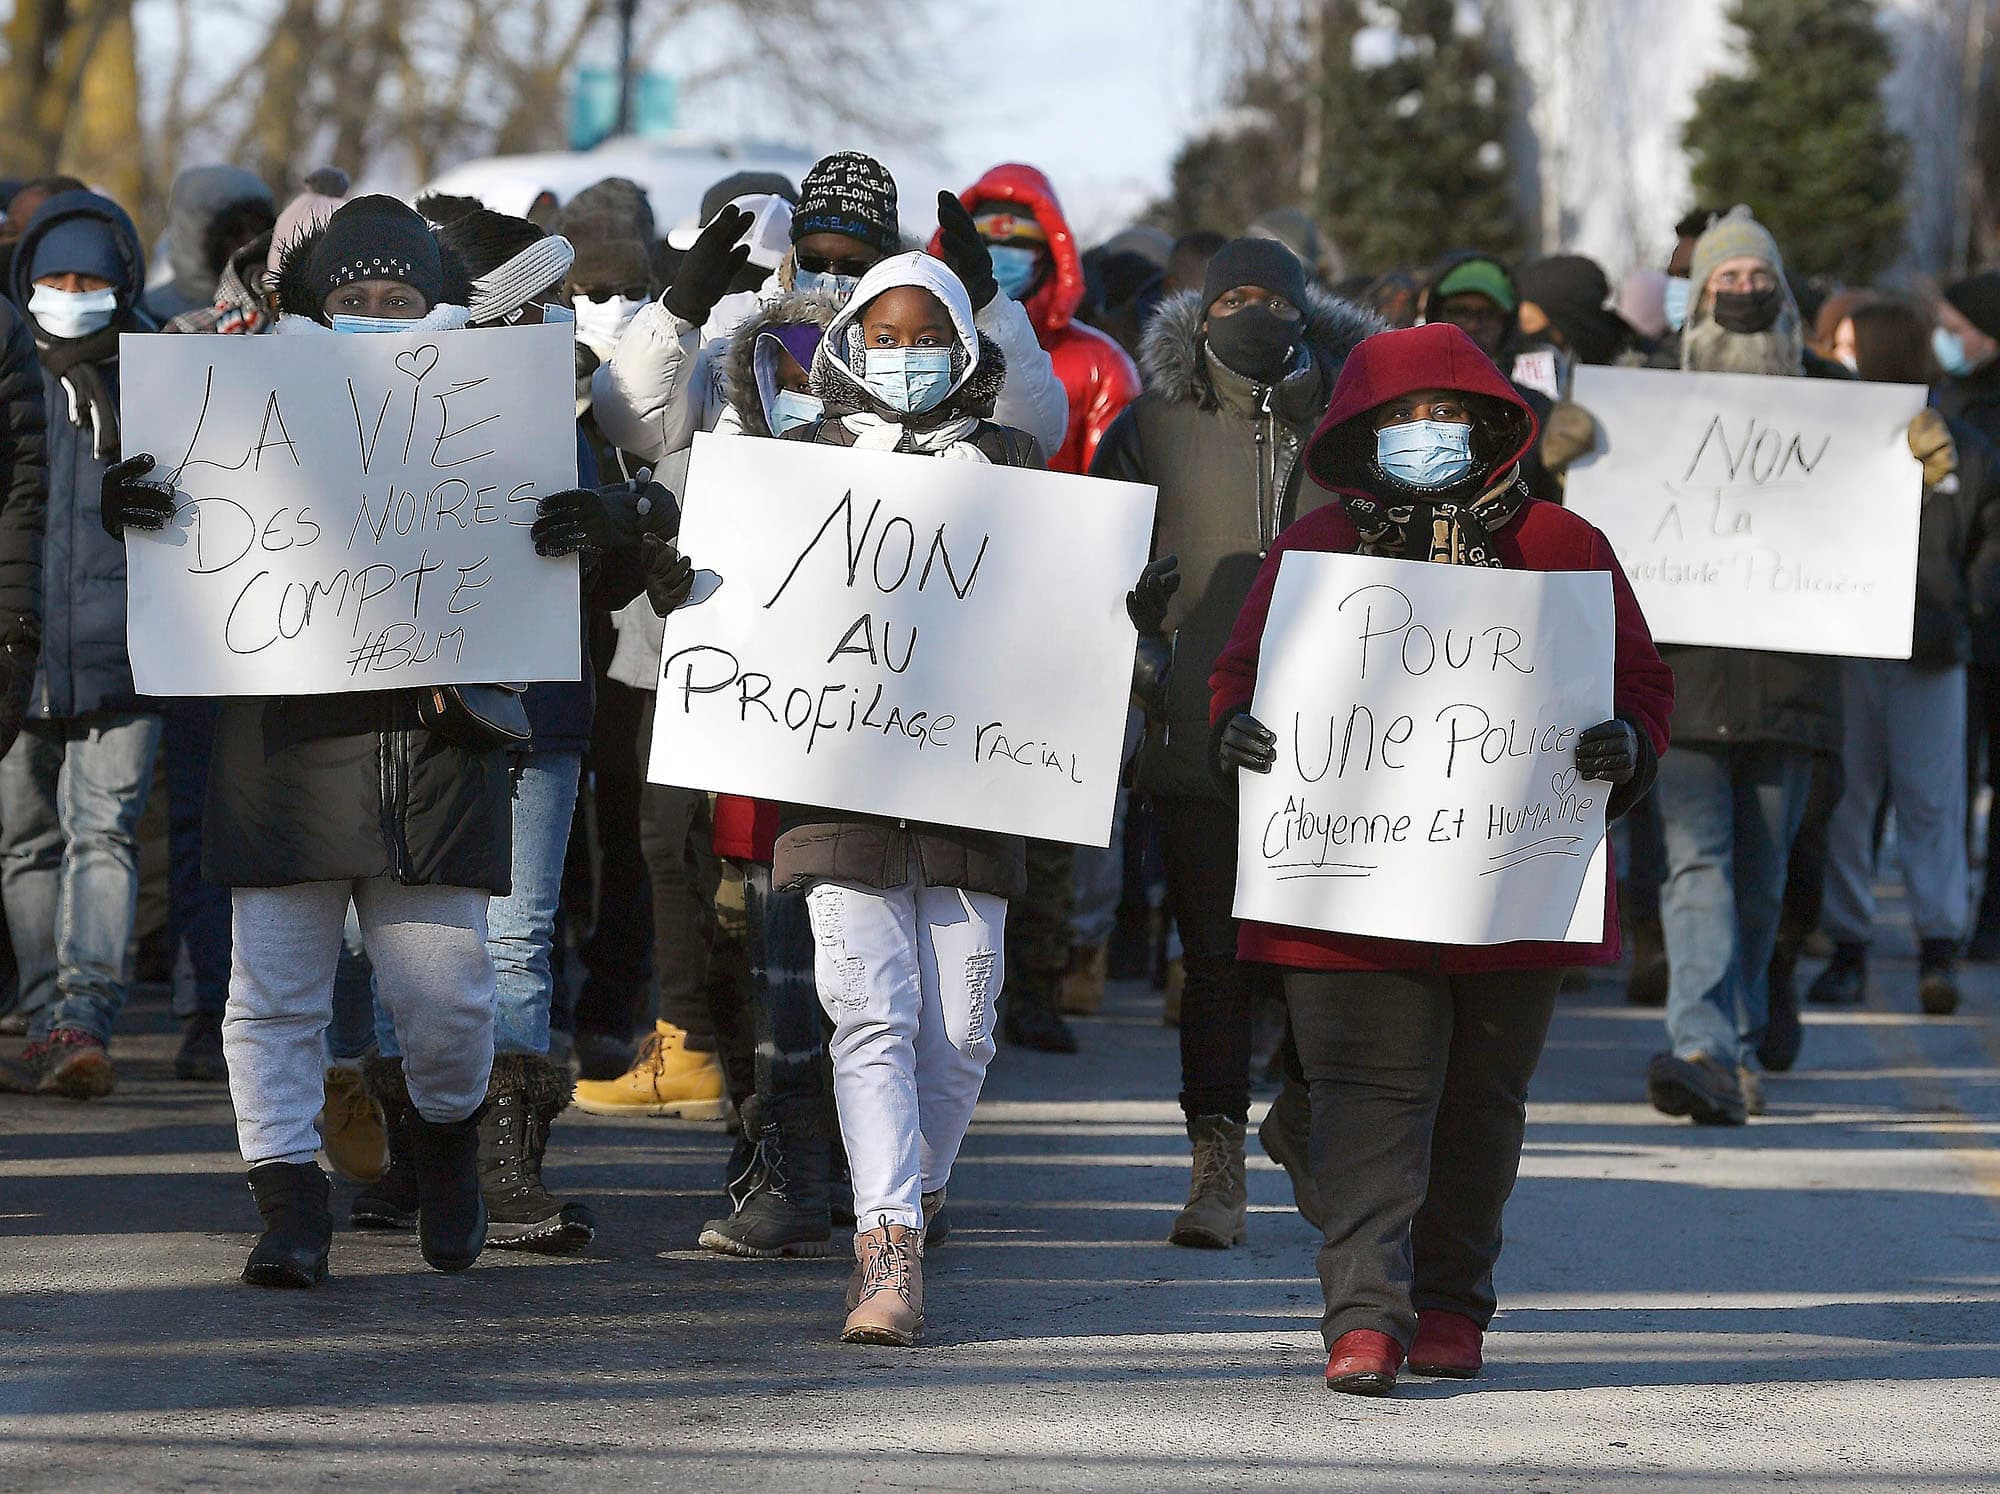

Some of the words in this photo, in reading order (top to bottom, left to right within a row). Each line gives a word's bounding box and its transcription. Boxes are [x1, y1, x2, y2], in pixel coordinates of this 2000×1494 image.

[335, 266, 405, 287] FEMME
[164, 364, 300, 486] LA
[1682, 414, 1832, 485] NON
[169, 496, 322, 574] DES
[762, 488, 990, 609] NON
[826, 613, 918, 674] AU
[1338, 584, 1536, 680] POUR
[1262, 795, 1412, 869] Citoyenne
